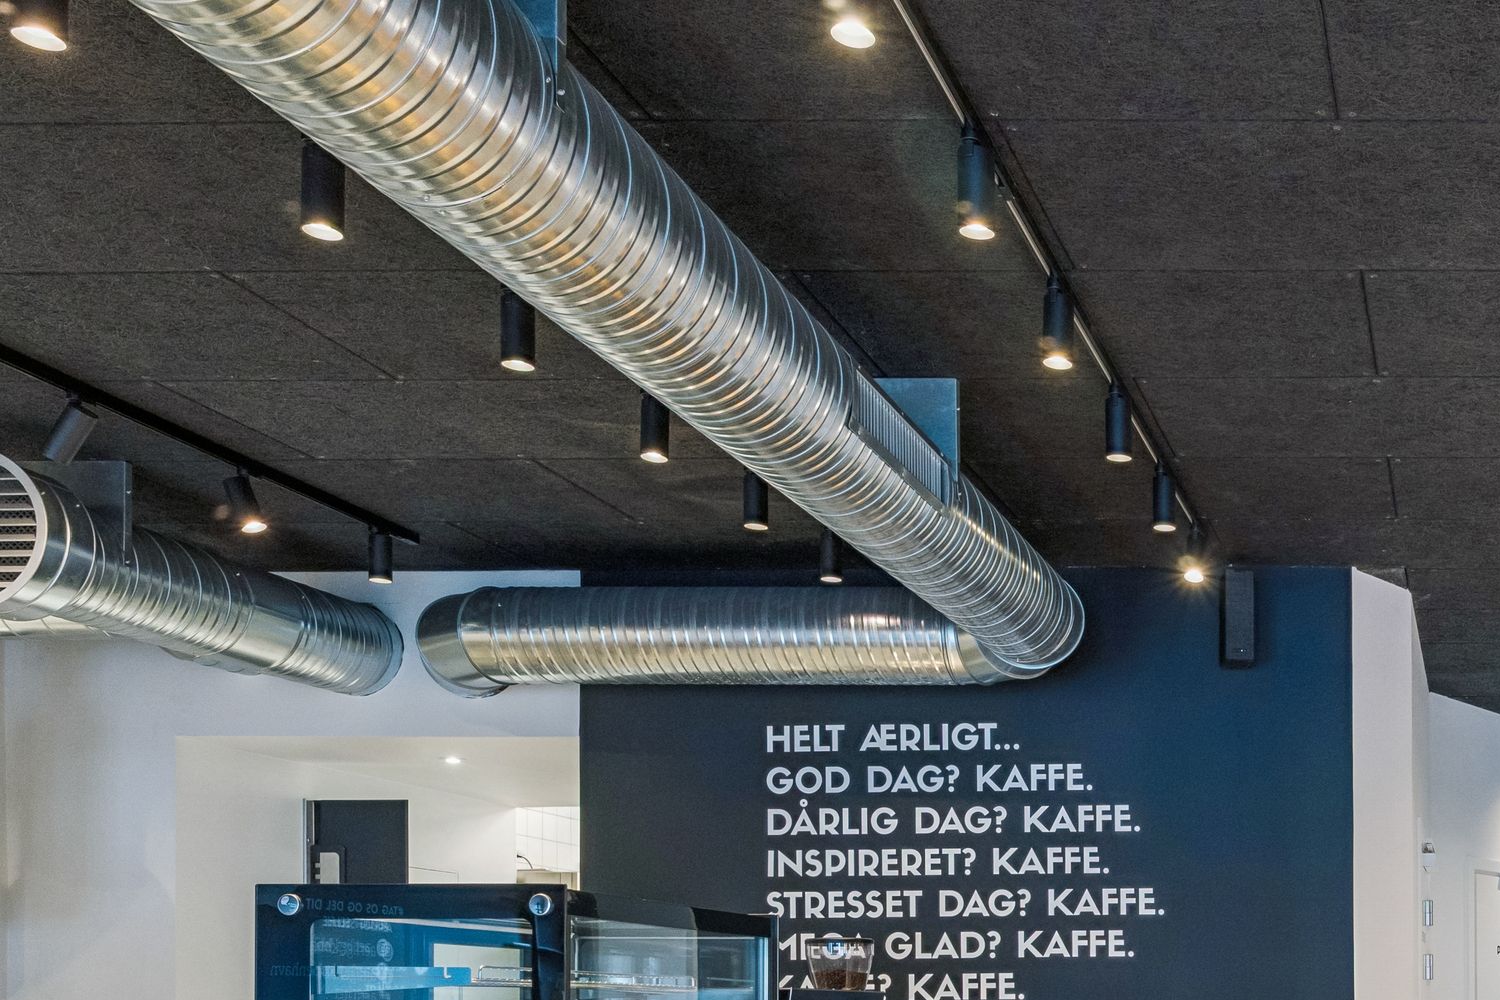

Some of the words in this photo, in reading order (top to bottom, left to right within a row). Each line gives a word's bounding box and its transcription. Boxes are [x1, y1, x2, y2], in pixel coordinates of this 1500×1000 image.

[766, 724, 846, 753] HELT
[859, 722, 1021, 752] ÆRLIGT...
[766, 765, 851, 794] GOD
[867, 764, 960, 793] DAG?
[976, 763, 1093, 792] KAFFE.
[766, 798, 899, 836] DÅRLIG
[914, 805, 1008, 835] DAG?
[1023, 804, 1141, 833] KAFFE.
[767, 847, 977, 878] INSPIRERET?
[992, 846, 1110, 875] KAFFE.
[766, 889, 923, 919] STRESSET
[938, 888, 1032, 918] DAG?
[1047, 887, 1165, 916] KAFFE.
[884, 930, 1002, 960] GLAD?
[1017, 929, 1135, 959] KAFFE.
[908, 972, 1025, 1000] KAFFE.
